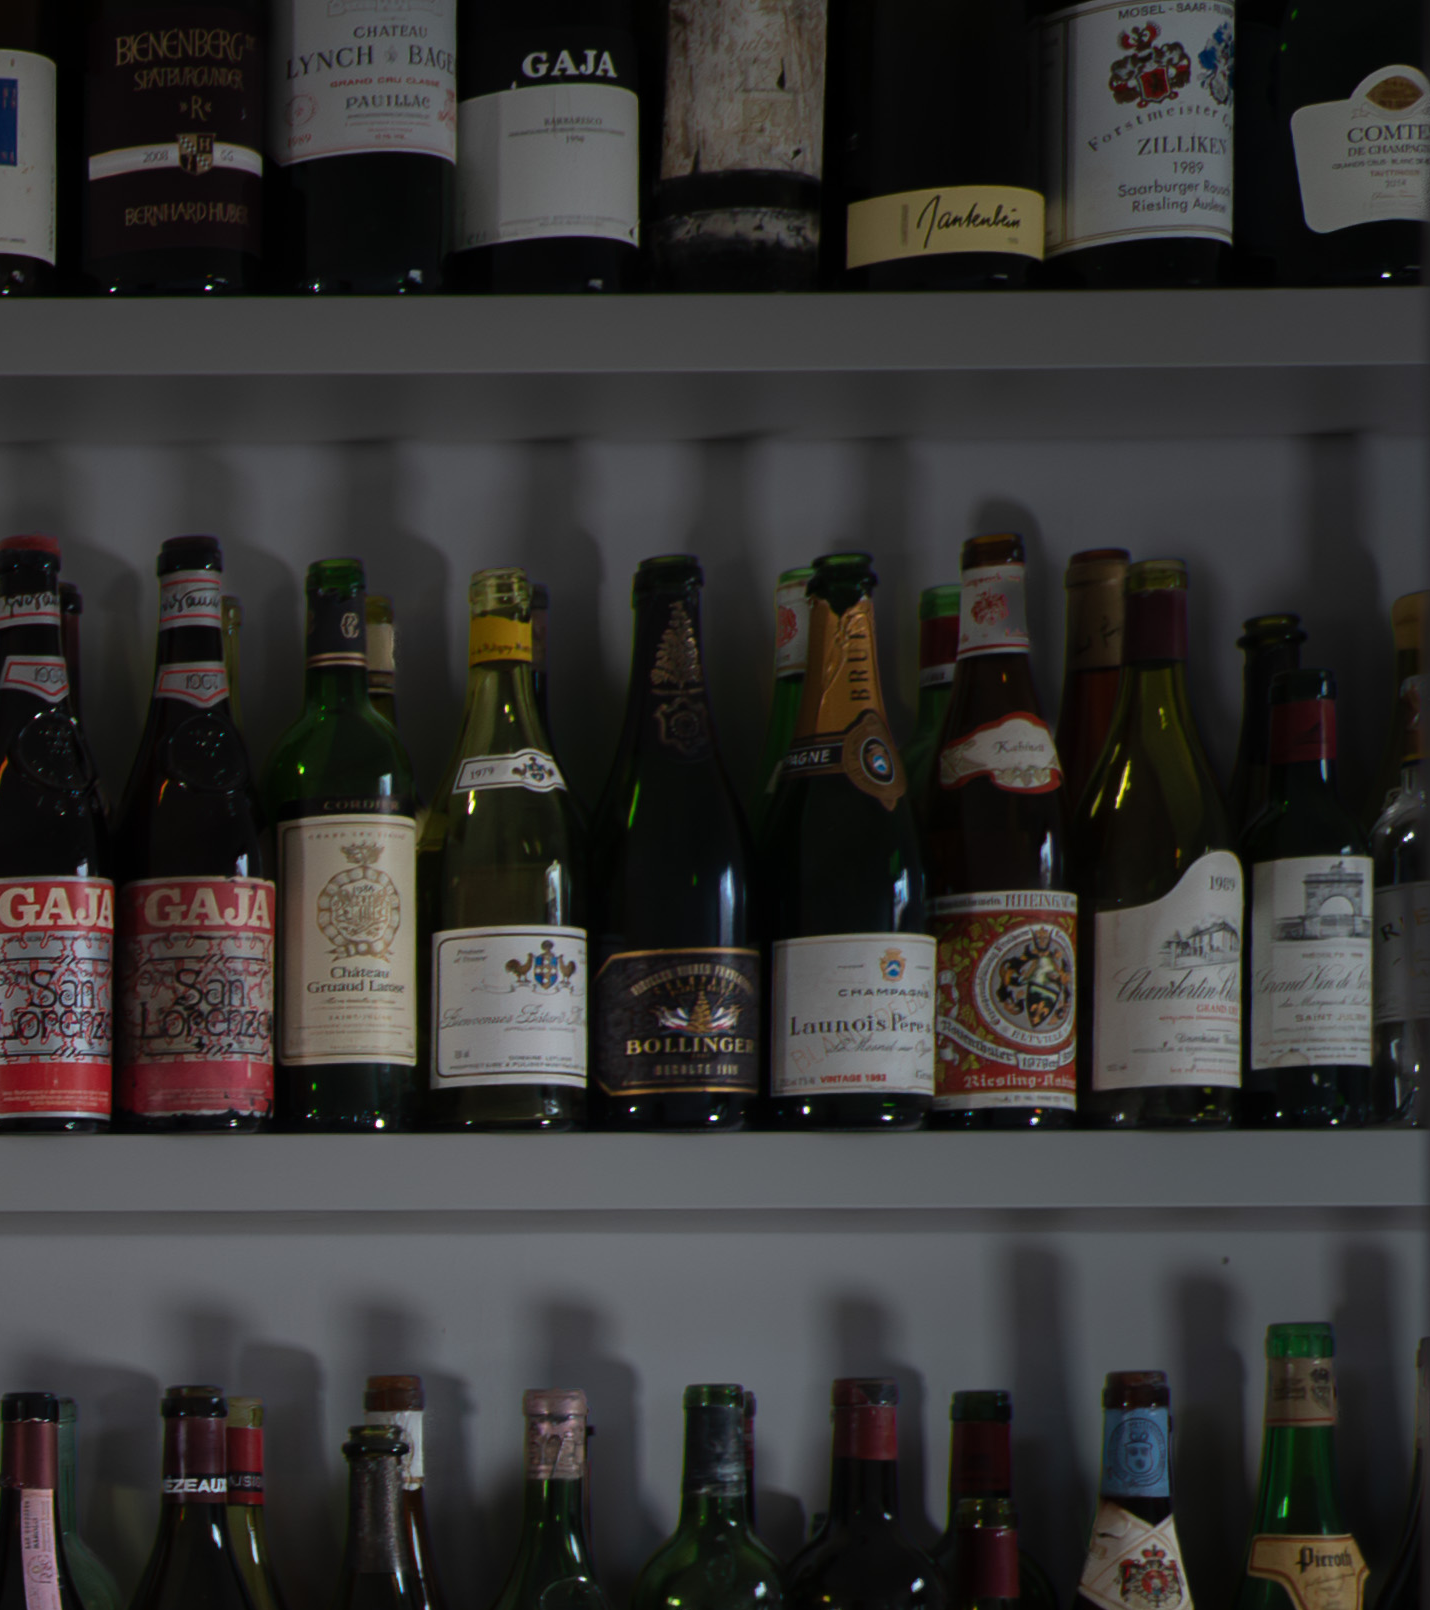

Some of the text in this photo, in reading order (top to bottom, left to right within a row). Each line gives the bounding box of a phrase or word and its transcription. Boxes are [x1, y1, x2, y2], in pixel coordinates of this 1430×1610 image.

[353, 25, 429, 39] CHATEAU
[286, 45, 375, 81] LYNCH
[521, 49, 618, 79] GAJA
[345, 95, 431, 110] PAUILLAC
[1171, 159, 1204, 174] 1989
[124, 203, 248, 227] BERNHARD HUBER
[1207, 874, 1237, 892] 1989
[143, 886, 271, 929] GAJA
[30, 970, 96, 1008] San
[174, 967, 245, 1008] San
[789, 1014, 885, 1038] Launois
[624, 1036, 755, 1057] BOLLINGER
